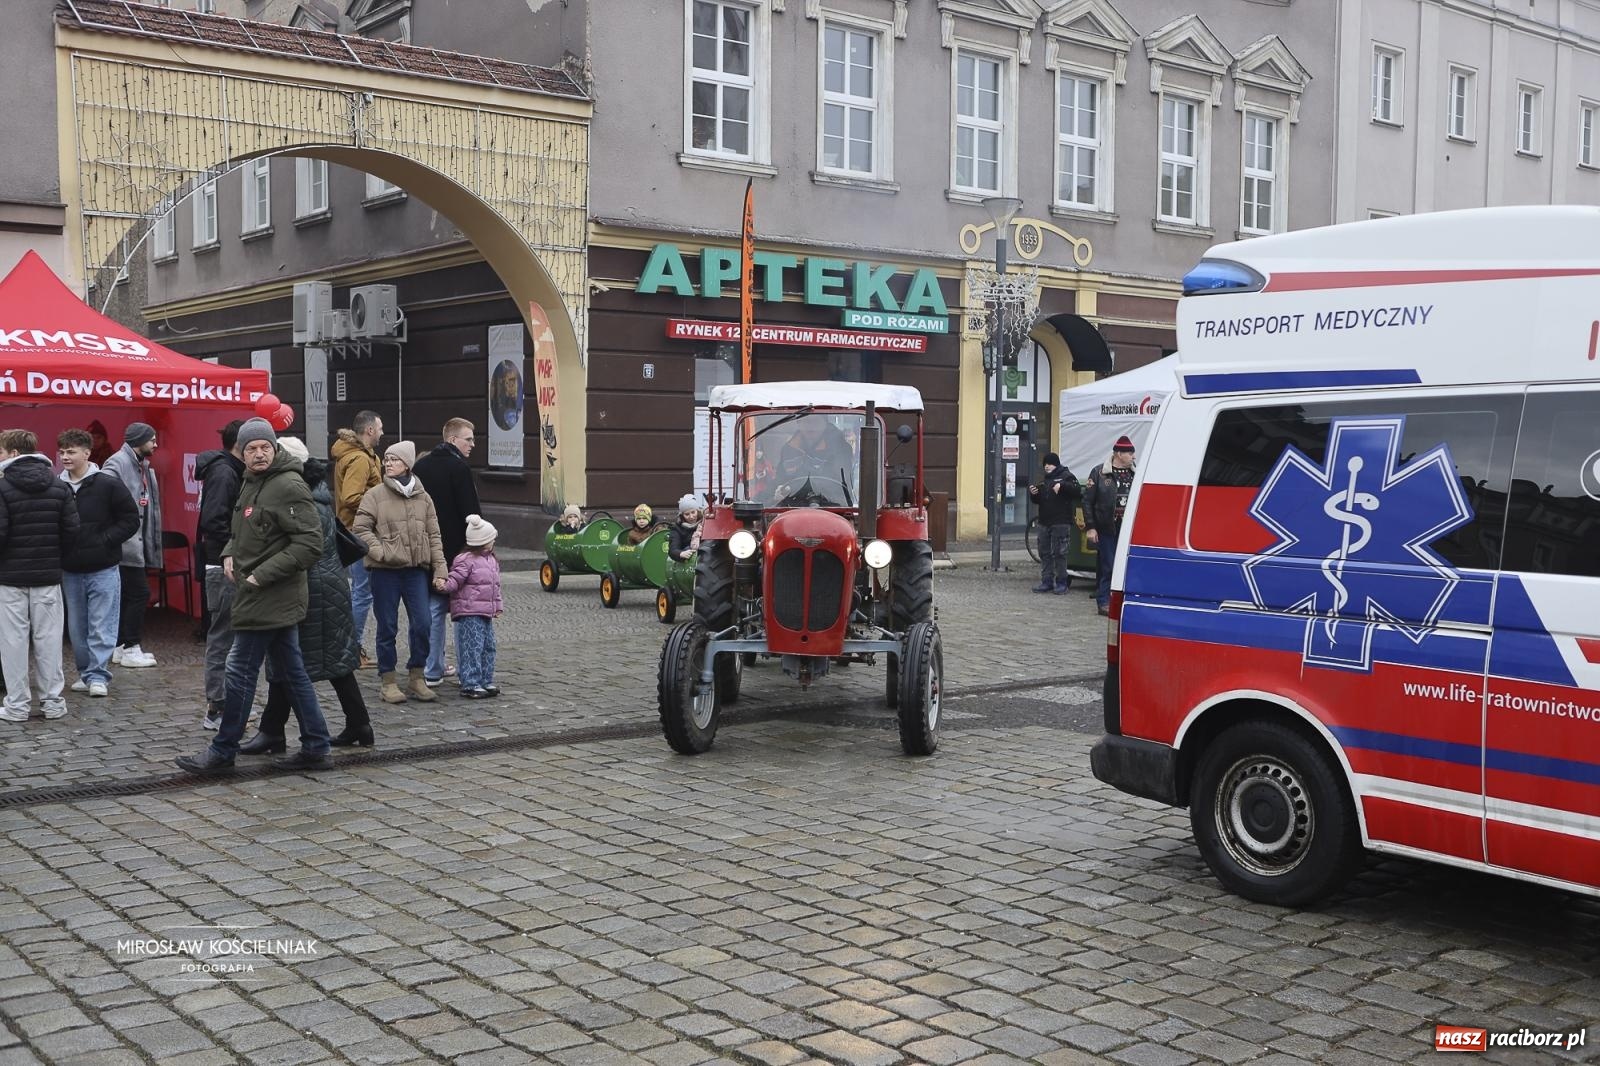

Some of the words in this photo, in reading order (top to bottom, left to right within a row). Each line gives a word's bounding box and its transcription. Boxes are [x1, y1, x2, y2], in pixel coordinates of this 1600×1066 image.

[635, 243, 949, 316] APTEKA
[675, 323, 721, 338] RYNEK
[726, 327, 741, 338] 12
[752, 328, 813, 344] CENTRUM
[816, 332, 922, 350] FARMACEUTYCZNE
[851, 314, 882, 326] POD
[887, 316, 944, 331] RÓŻAMI
[1195, 314, 1304, 338] TRANSPORT
[1314, 305, 1433, 331] MEDYCZNY
[27, 371, 132, 401] Dawcą
[141, 377, 241, 404] szpiku!
[1101, 404, 1138, 415] Raciborskie
